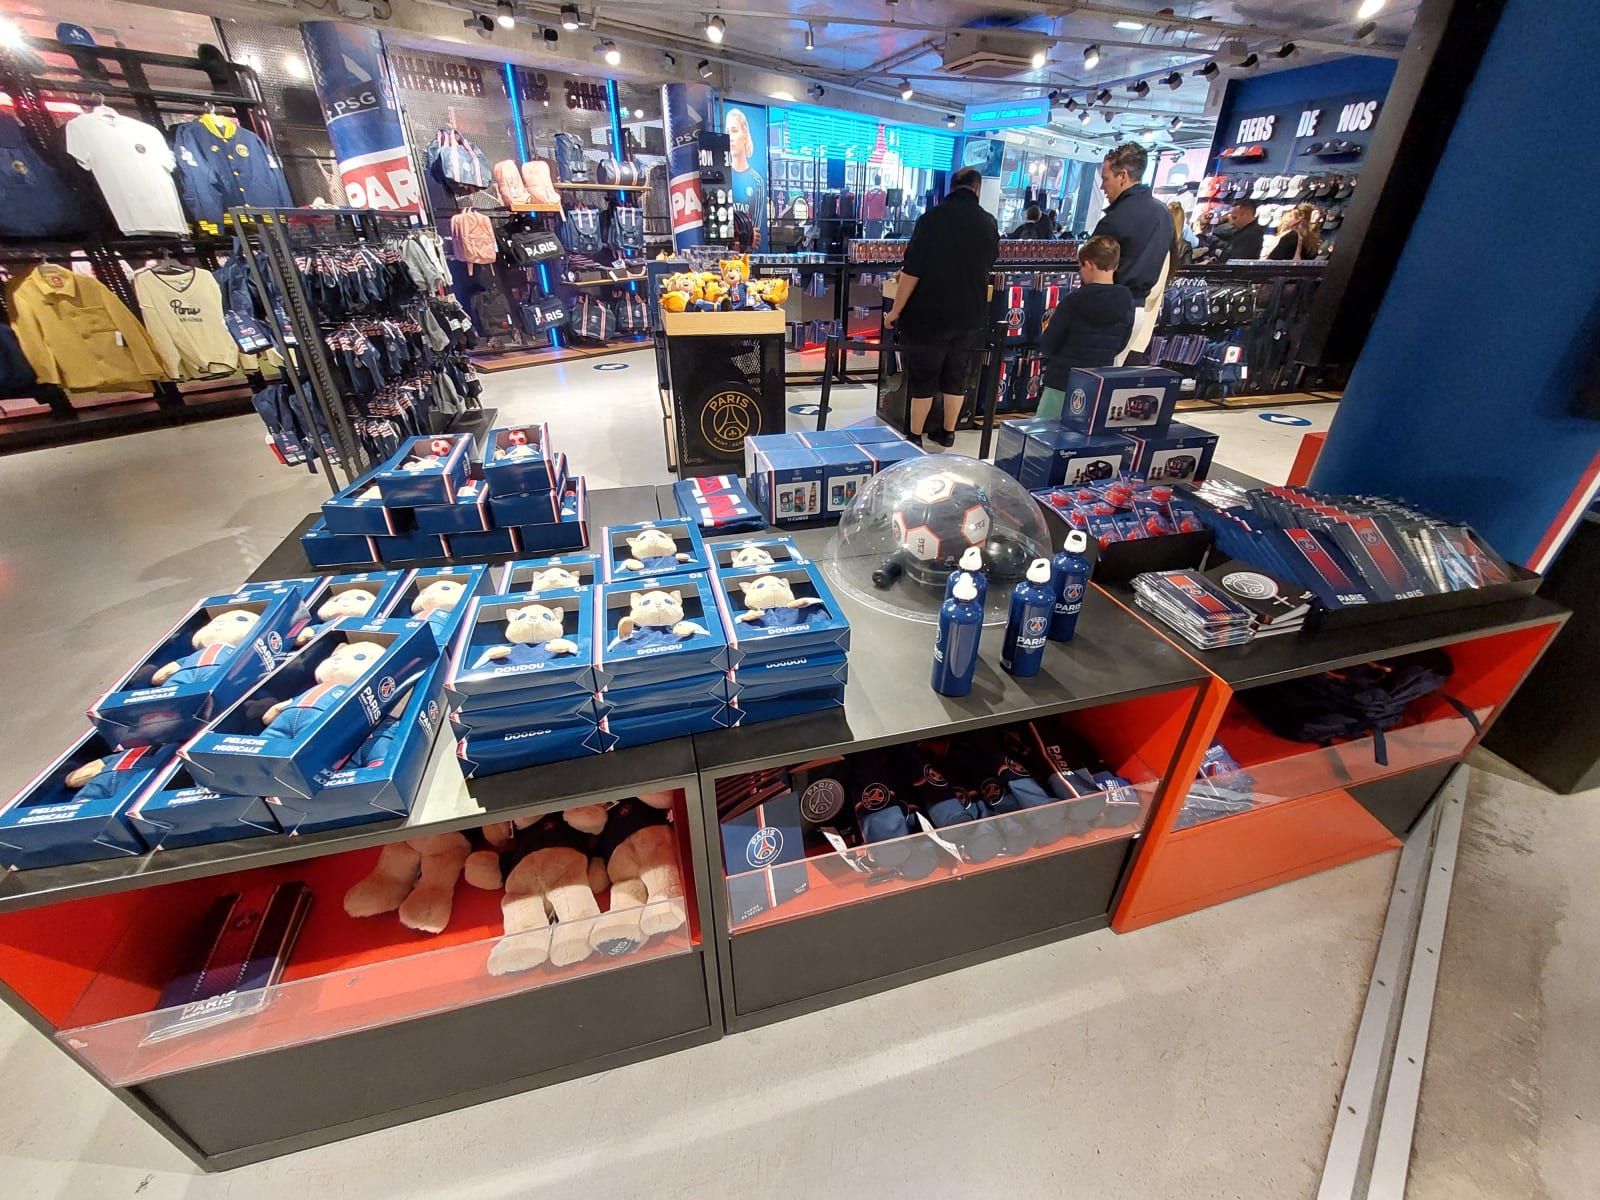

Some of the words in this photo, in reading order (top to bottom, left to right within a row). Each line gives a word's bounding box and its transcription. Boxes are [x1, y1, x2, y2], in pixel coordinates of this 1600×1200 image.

[333, 92, 376, 115] PSG
[1236, 114, 1276, 144] FIERS
[1296, 109, 1321, 138] DE
[1336, 100, 1377, 133] NOS
[733, 202, 750, 213] ATAR
[525, 241, 557, 257] PARIS
[709, 394, 750, 411] PARIS
[1336, 593, 1366, 602] PARIS
[1394, 589, 1425, 600] PARIS
[1055, 602, 1082, 611] PARIS
[768, 624, 810, 635] DOUDOU
[1016, 635, 1047, 646] PARIS
[256, 638, 276, 670] PARIS
[637, 643, 683, 655] DOUDOU
[494, 662, 545, 673] DOUDOU
[363, 686, 381, 721] PARIS
[222, 737, 268, 746] PELUCHE
[212, 744, 263, 754] MUSICALE
[807, 782, 834, 796] PARIS
[752, 829, 776, 844] PARIS
